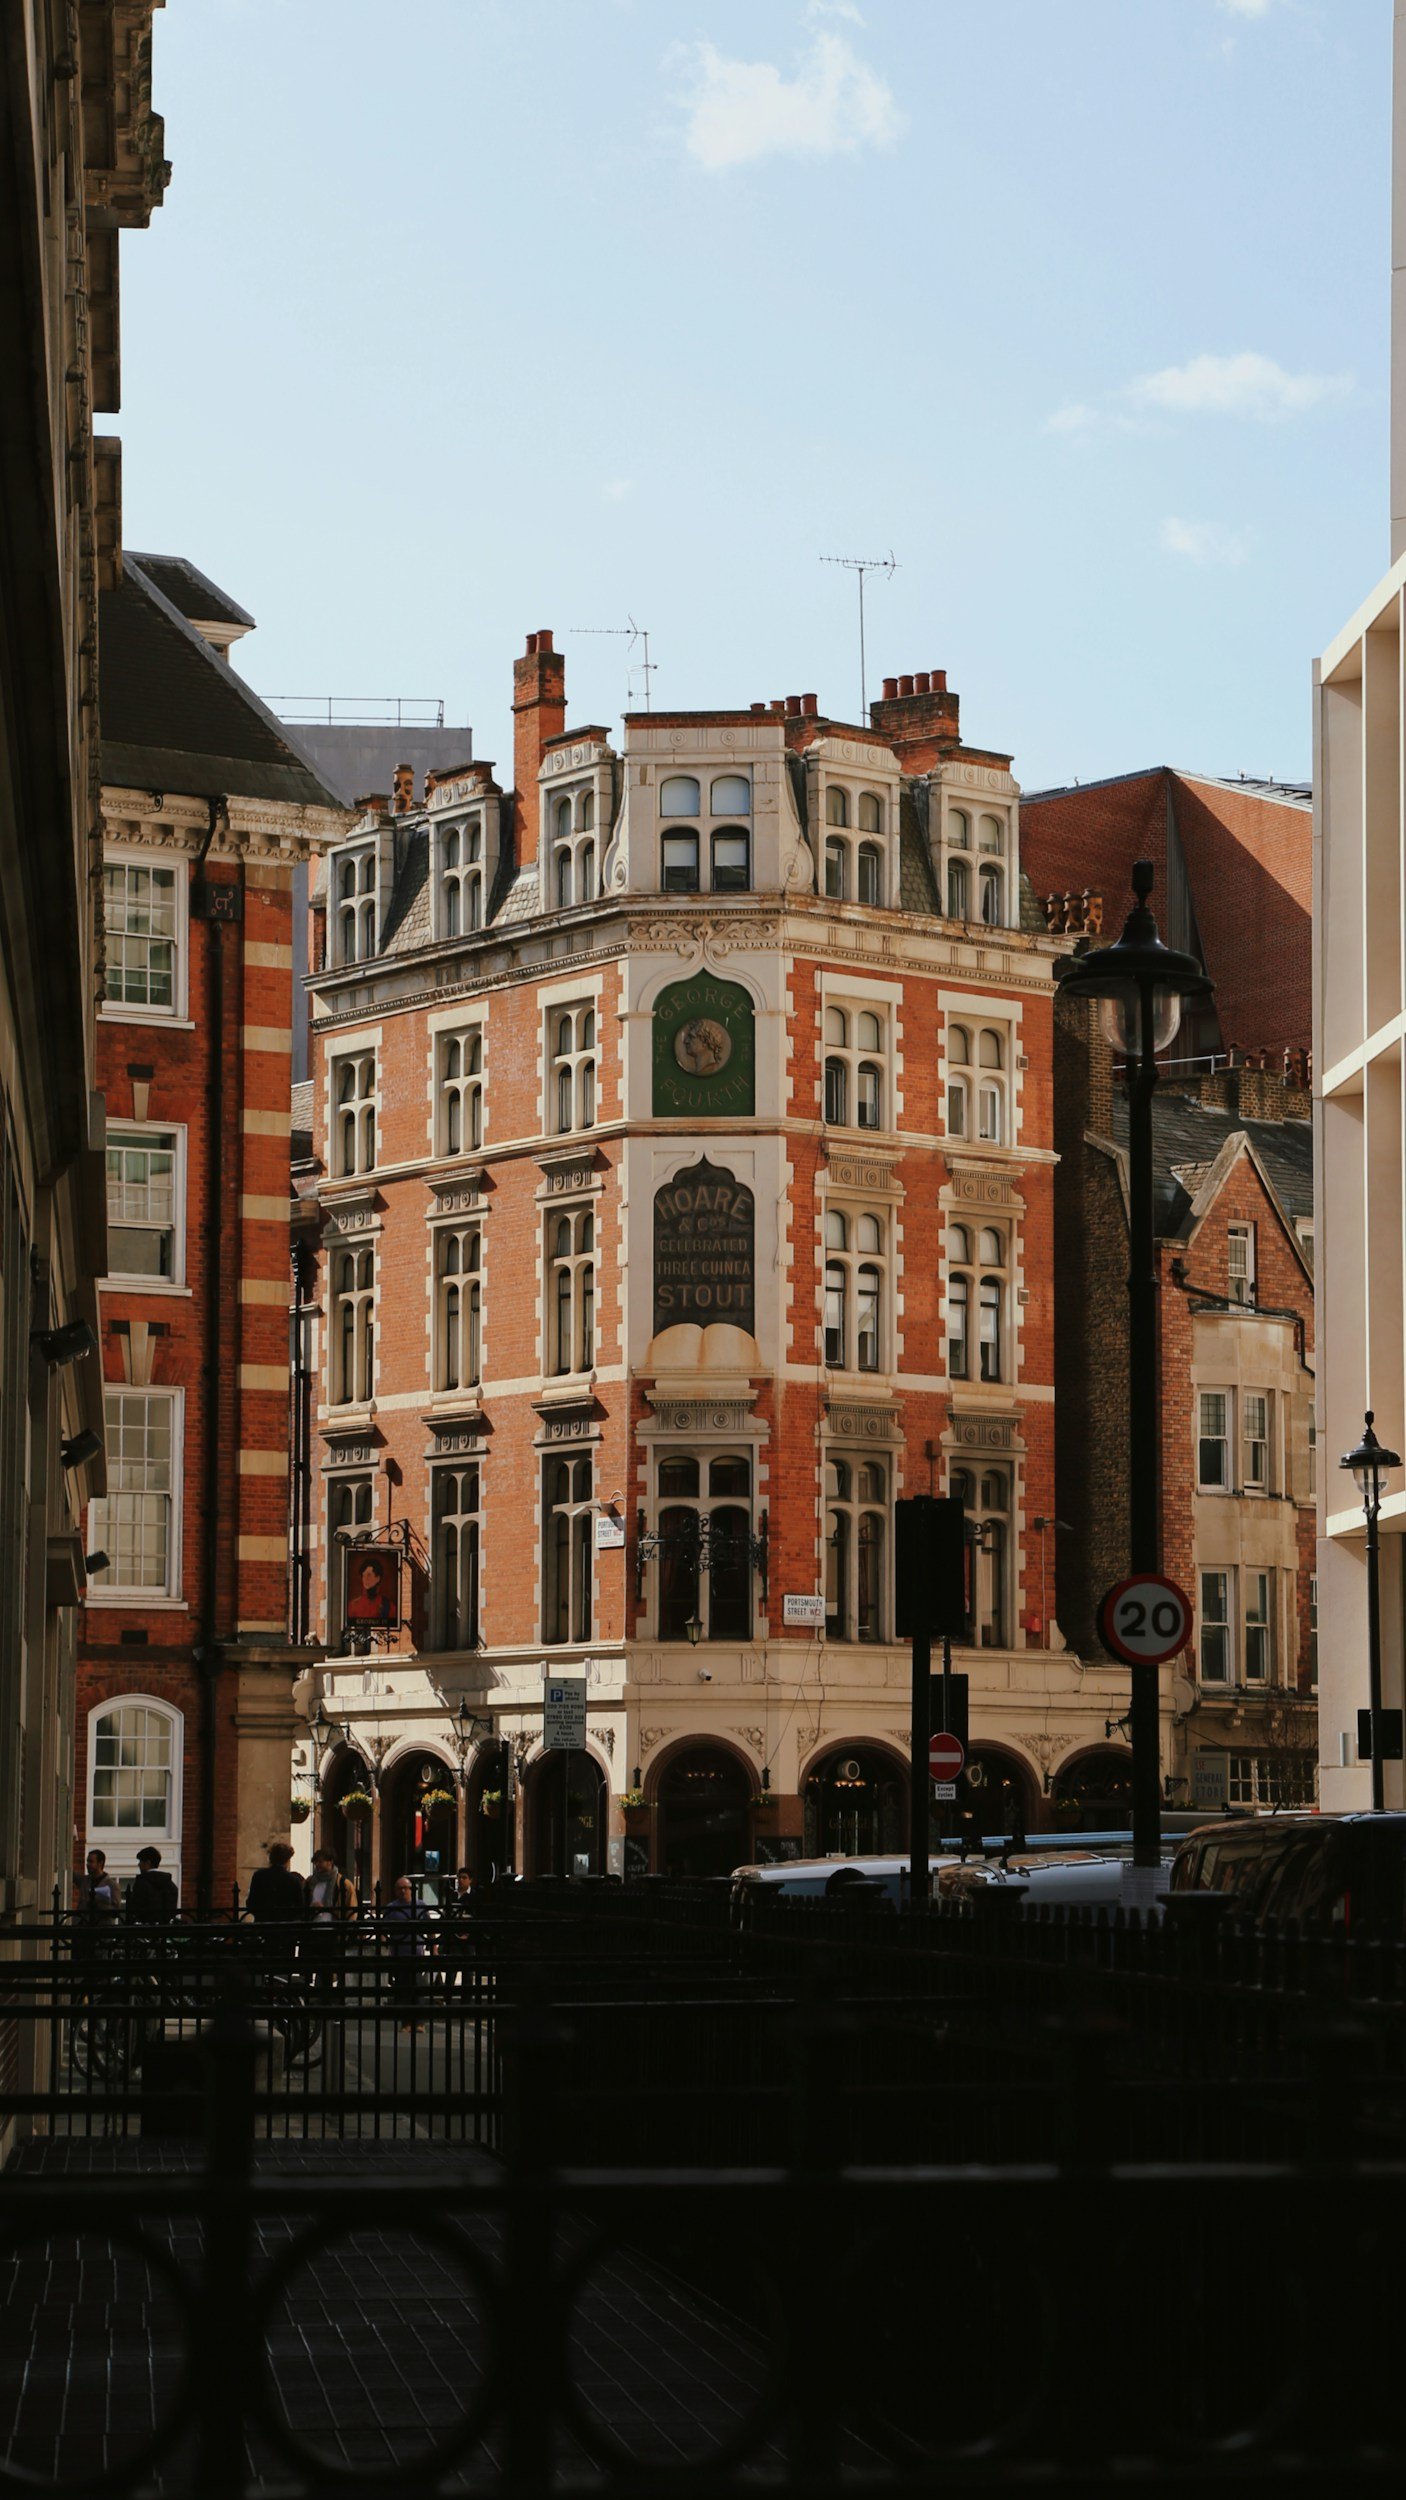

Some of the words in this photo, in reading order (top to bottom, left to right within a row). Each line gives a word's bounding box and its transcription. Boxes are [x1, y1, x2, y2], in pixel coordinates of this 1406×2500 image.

[658, 987, 748, 1021] GEORGE
[660, 1074, 750, 1109] FOURTH
[654, 1184, 752, 1221] HOARE
[659, 1239, 748, 1252] CELEBRATED
[656, 1260, 698, 1275] THREE
[657, 1283, 751, 1308] STOUT
[597, 1529, 612, 1538] STREET
[787, 1597, 823, 1607] PORTSMOUTH
[787, 1607, 807, 1616] STREET
[810, 1608, 821, 1617] WC2
[1120, 1601, 1181, 1638] 20
[553, 1690, 562, 1701] P
[1195, 1772, 1225, 1783] GENERAL
[1195, 1785, 1225, 1797] STORE
